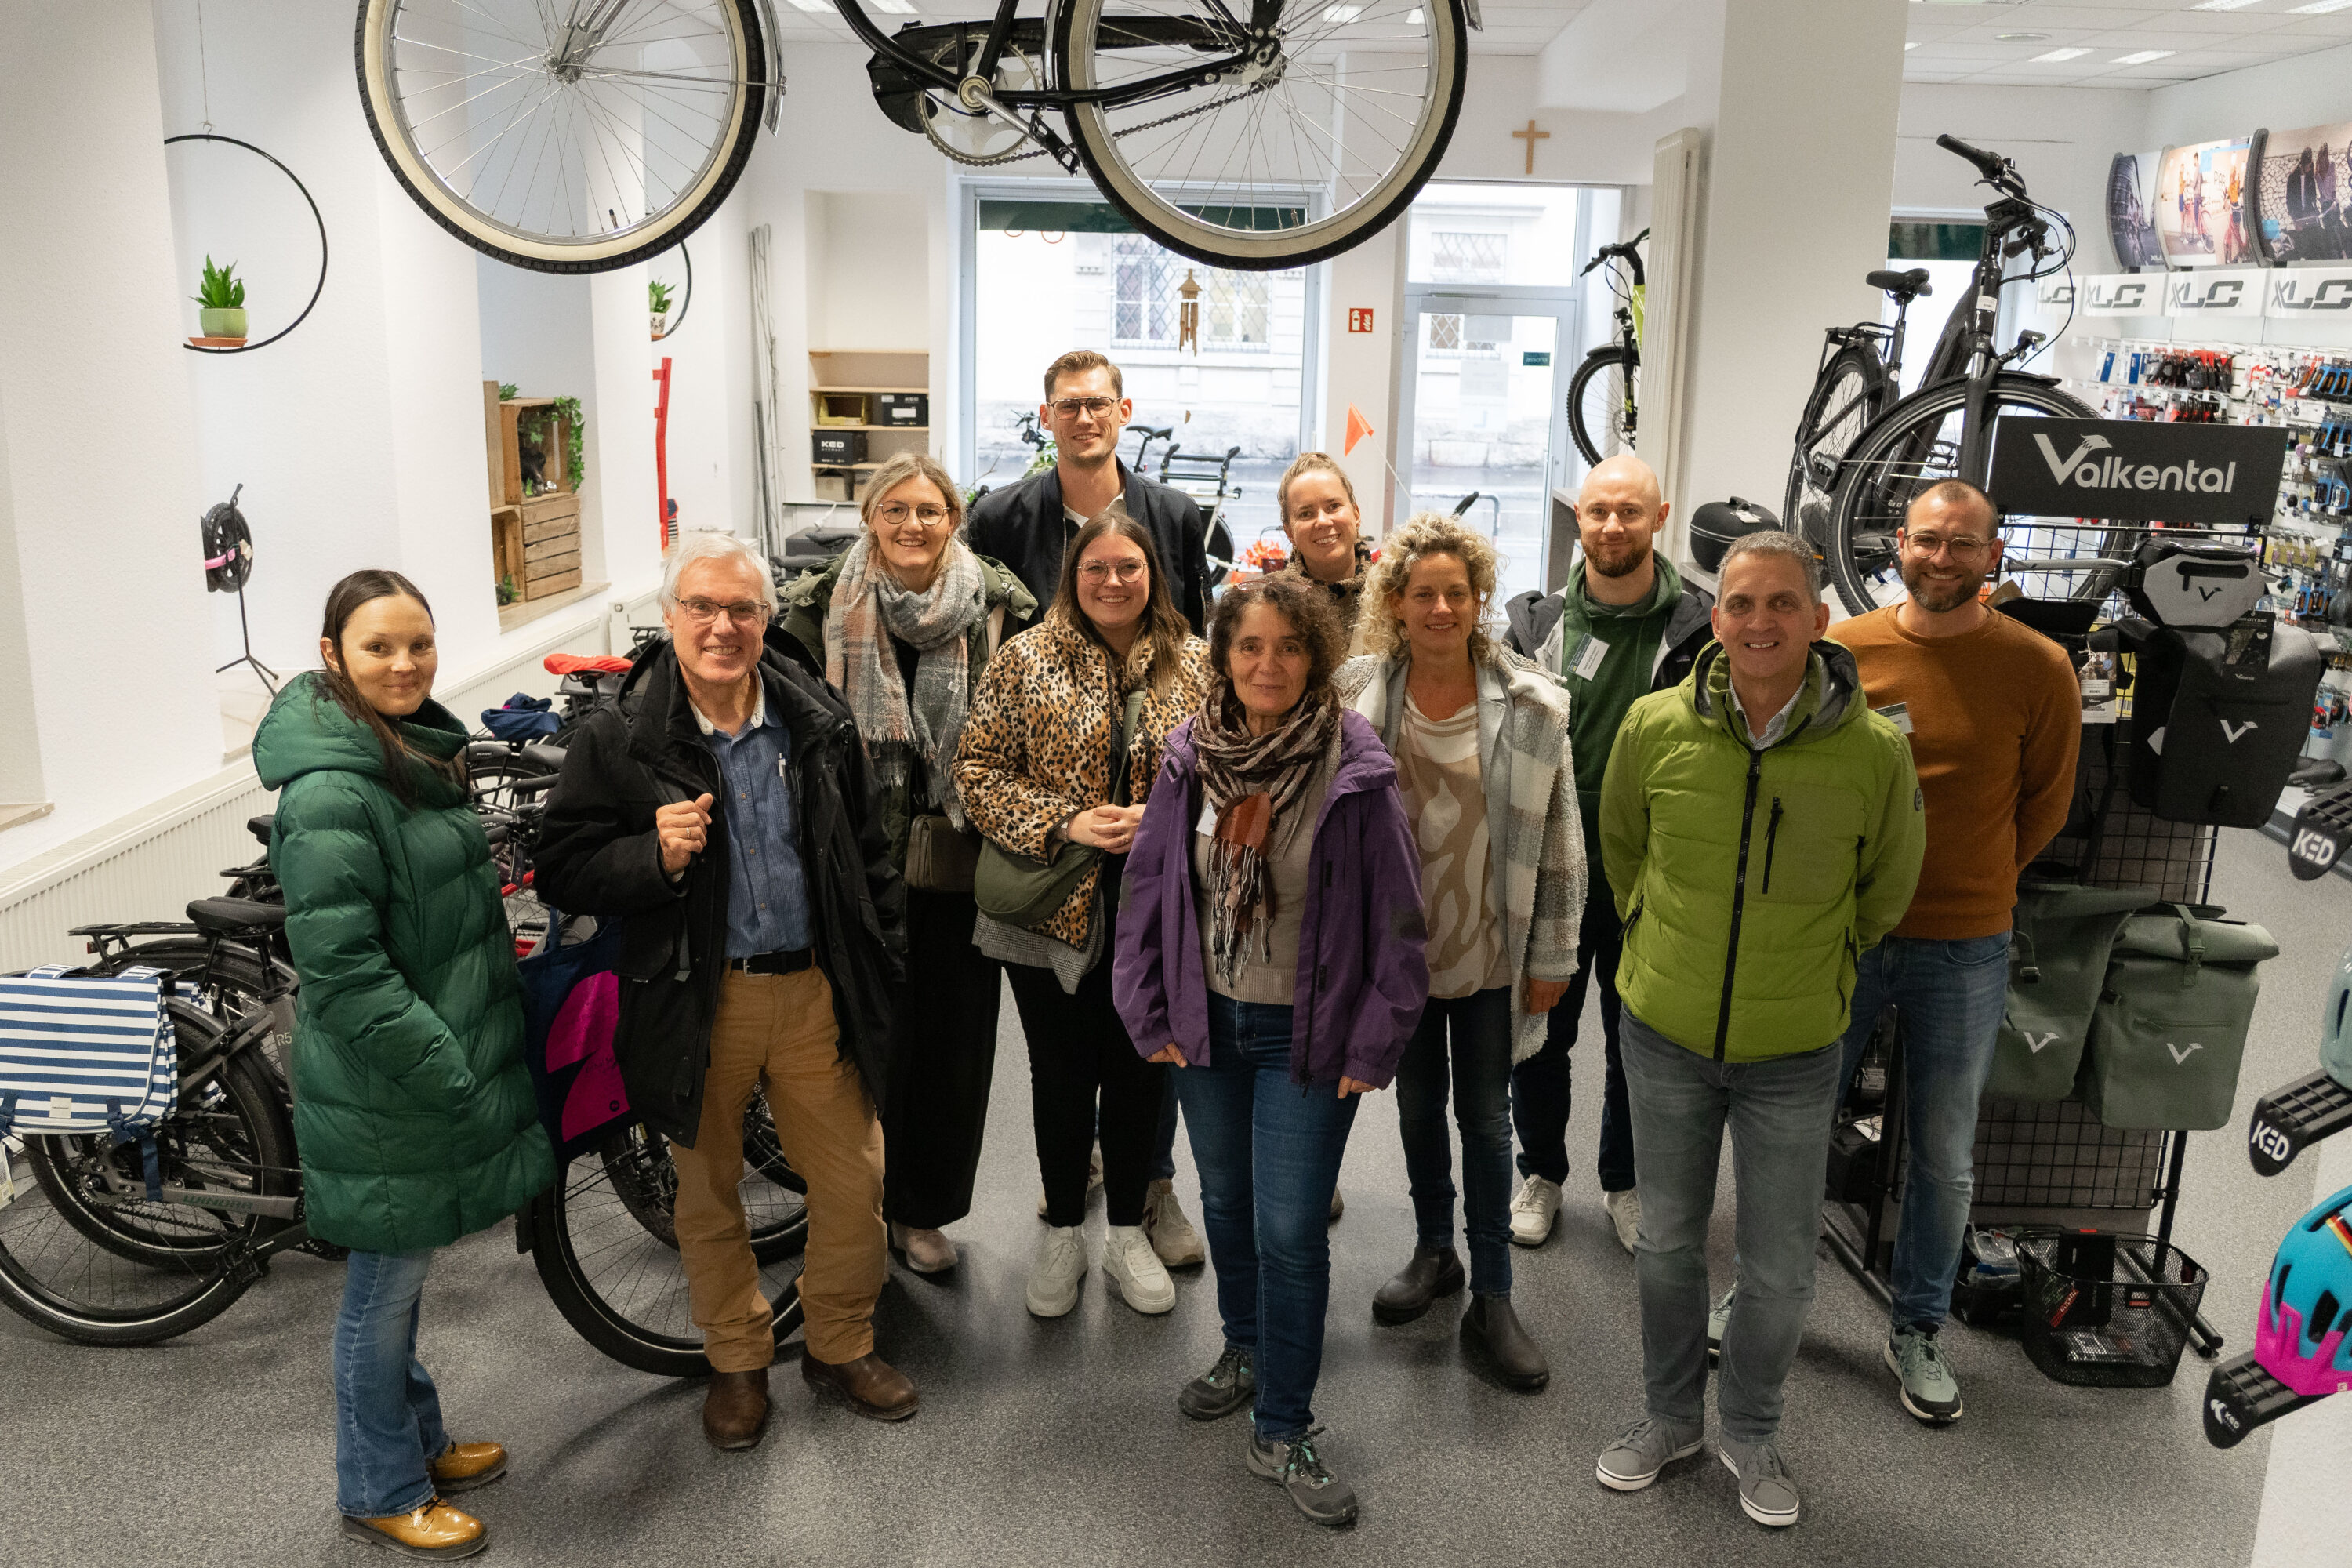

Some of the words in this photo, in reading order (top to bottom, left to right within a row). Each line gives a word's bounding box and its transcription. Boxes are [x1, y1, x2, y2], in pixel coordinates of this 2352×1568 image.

[2085, 283, 2146, 308] XLC
[2169, 281, 2244, 309] XLC
[2272, 279, 2352, 309] XLC
[2032, 433, 2237, 493] Valkental
[2291, 828, 2336, 866] KED
[277, 1032, 292, 1046] R5
[2251, 1120, 2290, 1161] KED
[2225, 1411, 2240, 1429] KED
